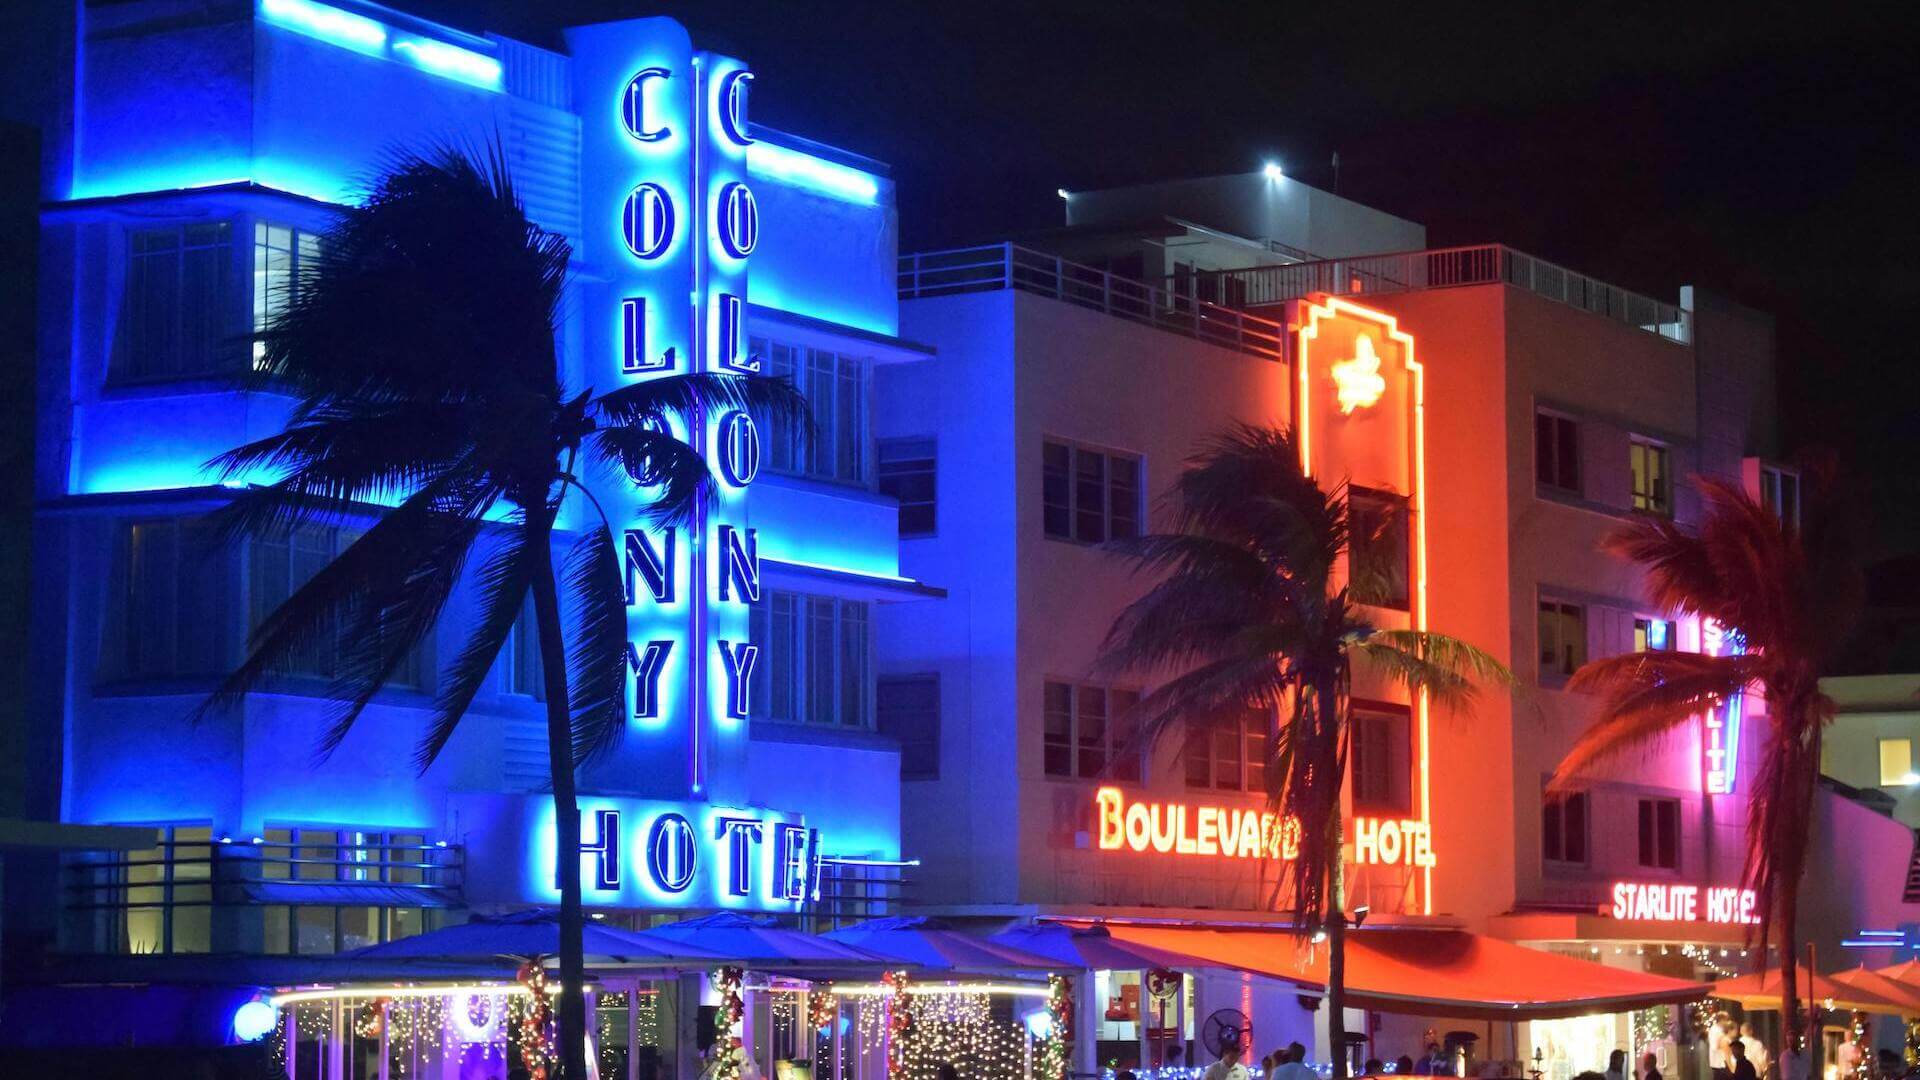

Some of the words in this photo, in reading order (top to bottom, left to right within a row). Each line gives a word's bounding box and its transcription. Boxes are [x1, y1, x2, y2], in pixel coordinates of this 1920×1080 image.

[717, 69, 760, 718] COLONY
[1704, 617, 1725, 793] STLITE
[1097, 787, 1301, 860] BOULEVARD
[1354, 817, 1435, 866] HOTEL
[1613, 882, 1698, 921] STARLITE
